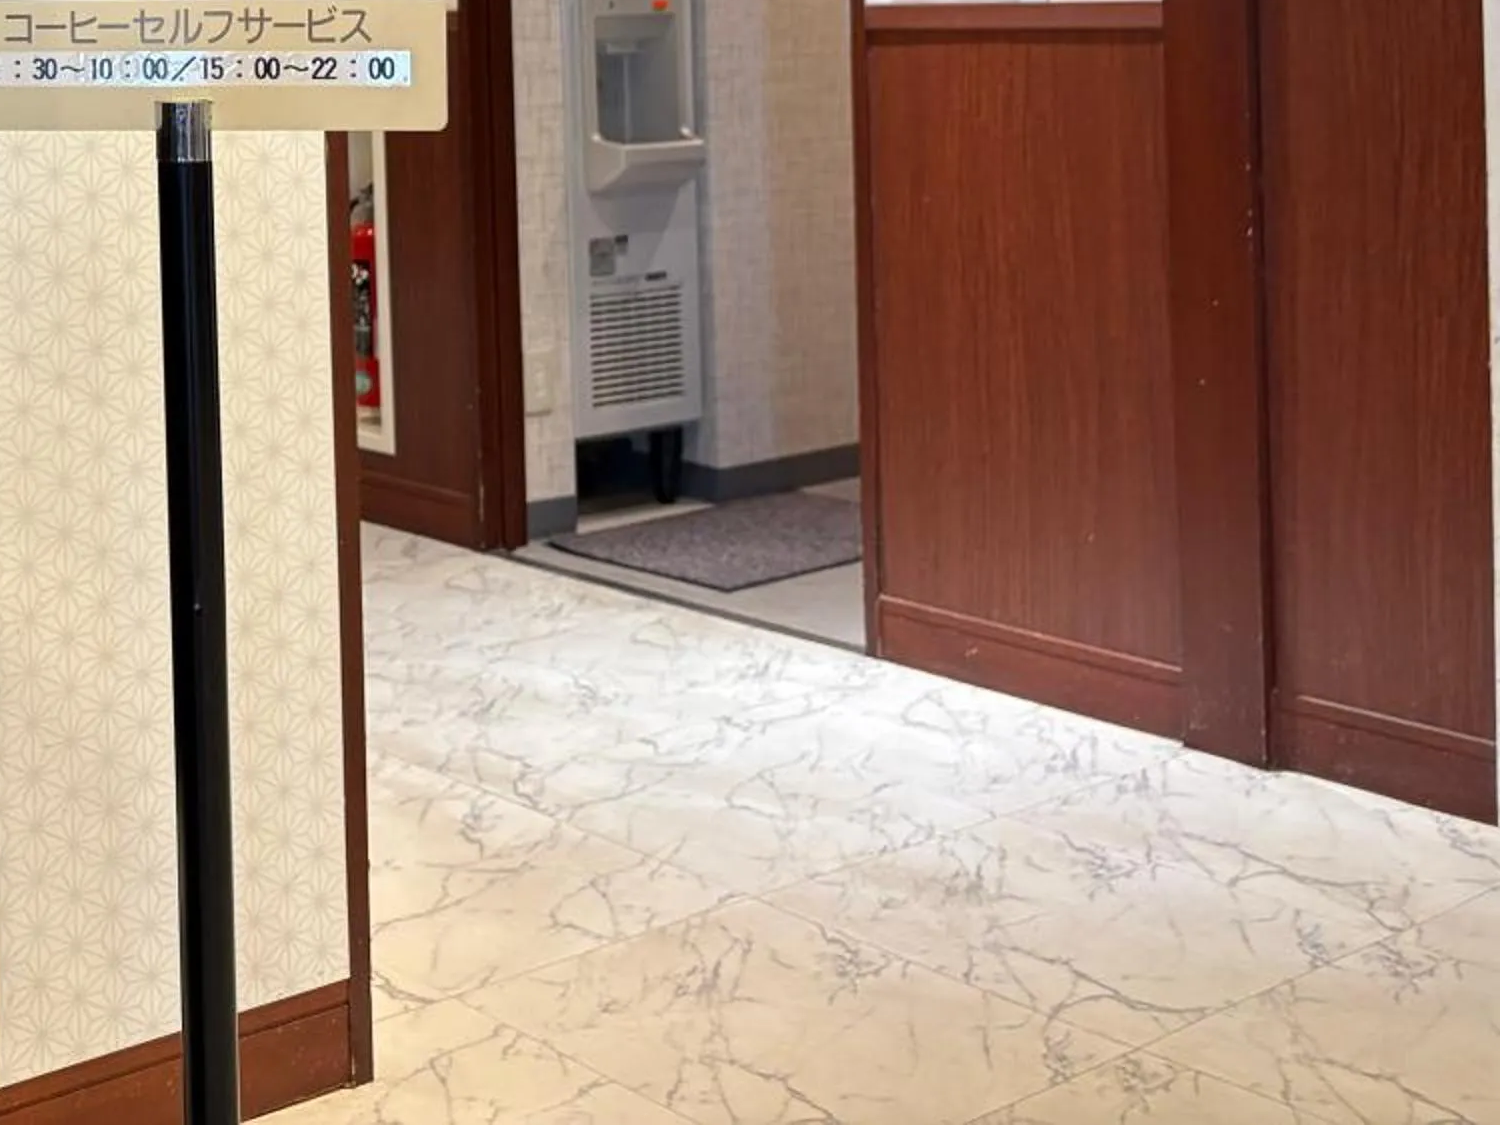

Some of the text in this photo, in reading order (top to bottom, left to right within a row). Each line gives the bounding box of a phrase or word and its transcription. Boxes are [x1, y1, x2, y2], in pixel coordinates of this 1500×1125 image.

[3, 5, 373, 45] コーヒーセルフサービス
